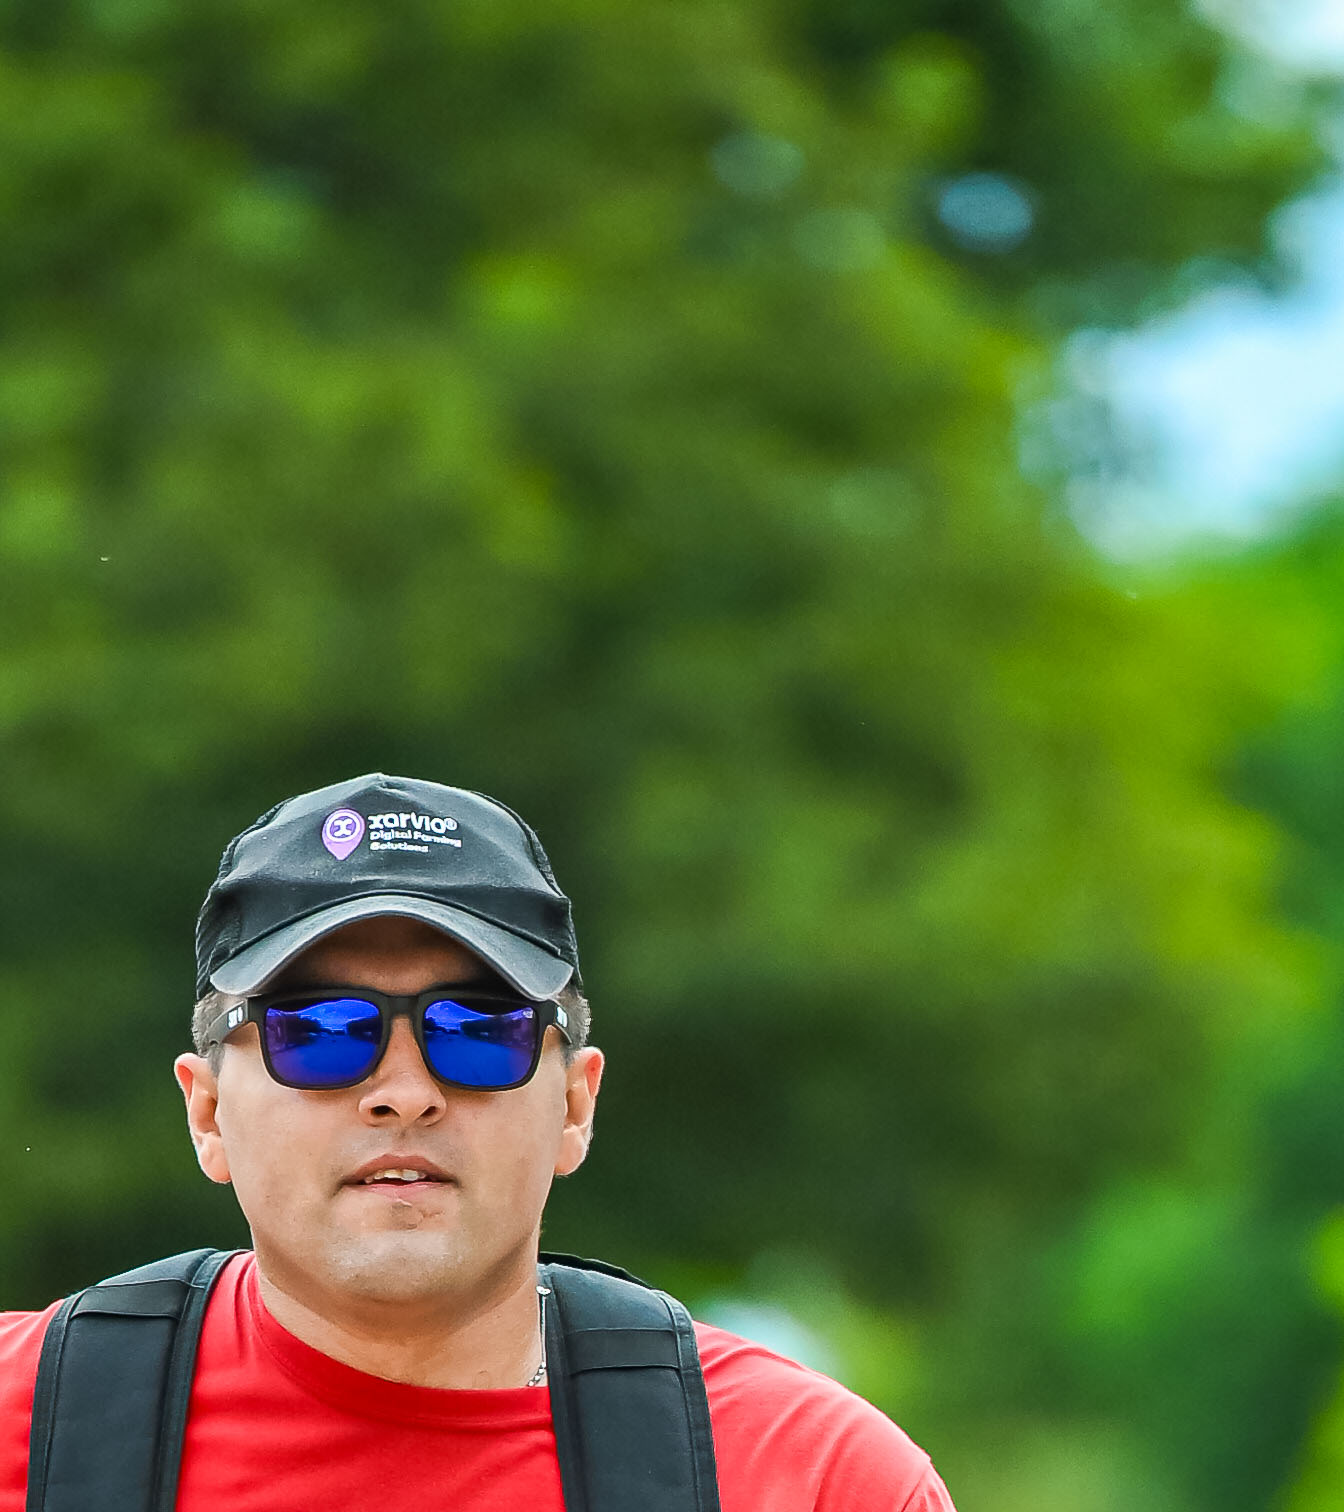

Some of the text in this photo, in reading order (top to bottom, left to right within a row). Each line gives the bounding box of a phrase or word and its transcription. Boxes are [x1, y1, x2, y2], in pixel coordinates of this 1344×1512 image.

[370, 830, 462, 848] Digital Farming
[370, 842, 429, 852] Solutions
